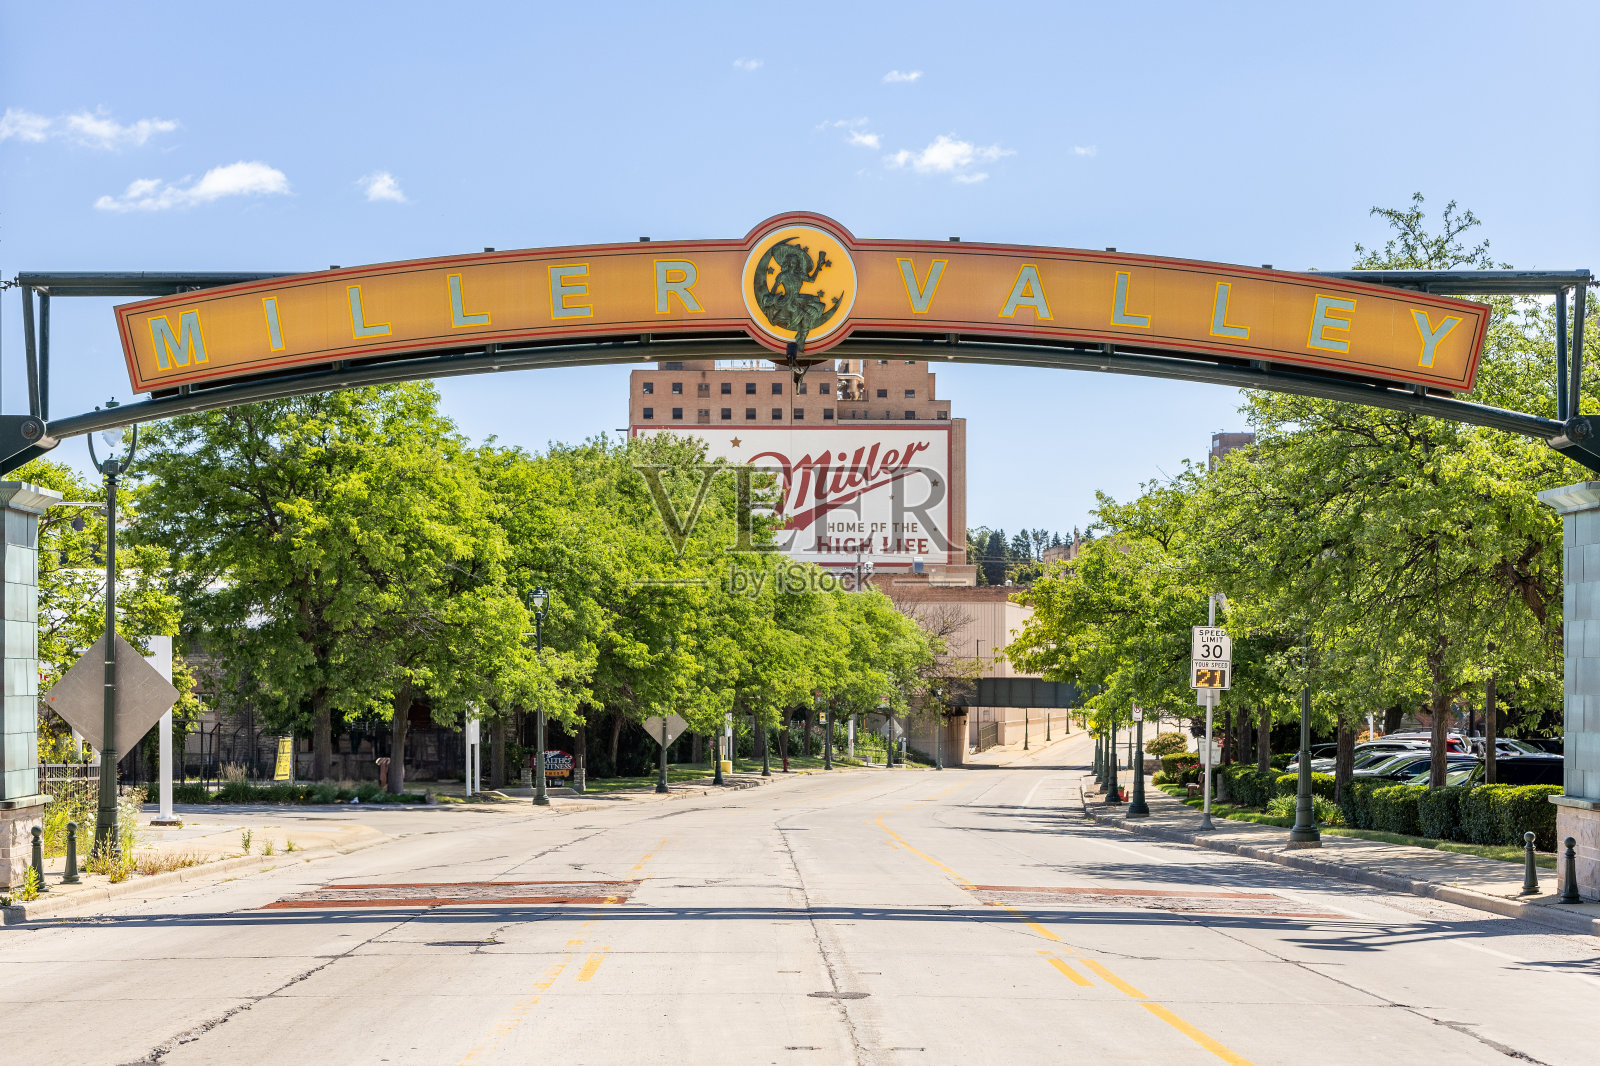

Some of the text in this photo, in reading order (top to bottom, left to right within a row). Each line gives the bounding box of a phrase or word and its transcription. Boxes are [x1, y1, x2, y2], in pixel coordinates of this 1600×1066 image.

[147, 257, 1463, 372] MILLER VALLEY
[746, 441, 930, 517] Miller
[827, 522, 918, 533] HOME OF THE
[817, 536, 929, 555] HIGH LIFE
[1201, 644, 1223, 659] 30
[1197, 669, 1222, 687] 21
